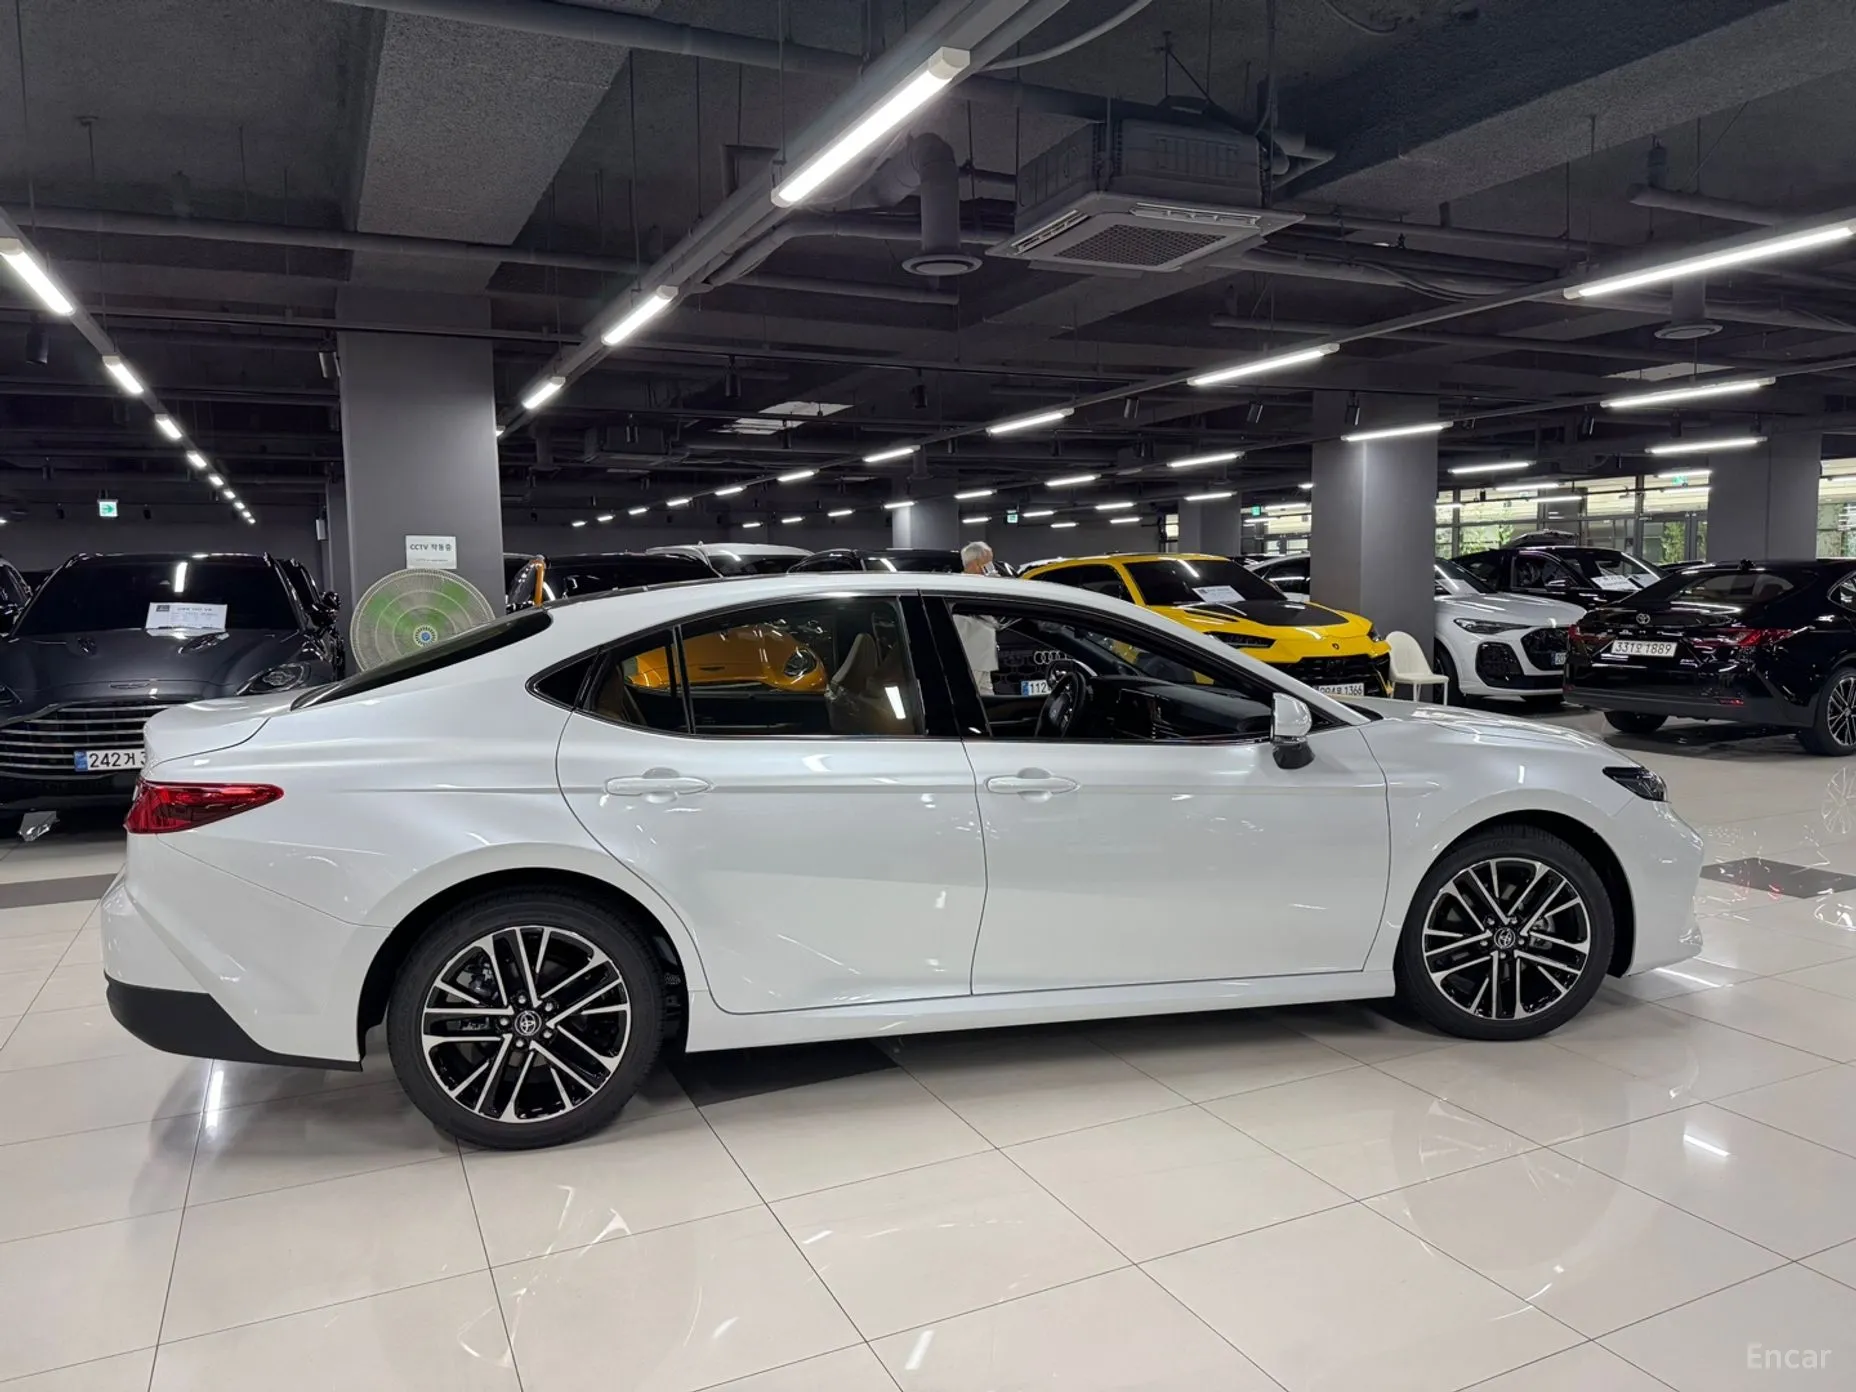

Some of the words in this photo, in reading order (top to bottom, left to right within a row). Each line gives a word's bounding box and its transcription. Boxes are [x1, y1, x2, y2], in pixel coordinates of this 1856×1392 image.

[410, 543, 429, 551] CCTV
[1615, 641, 1641, 653] 331오
[1645, 643, 1672, 655] 1889
[89, 752, 136, 768] 242거
